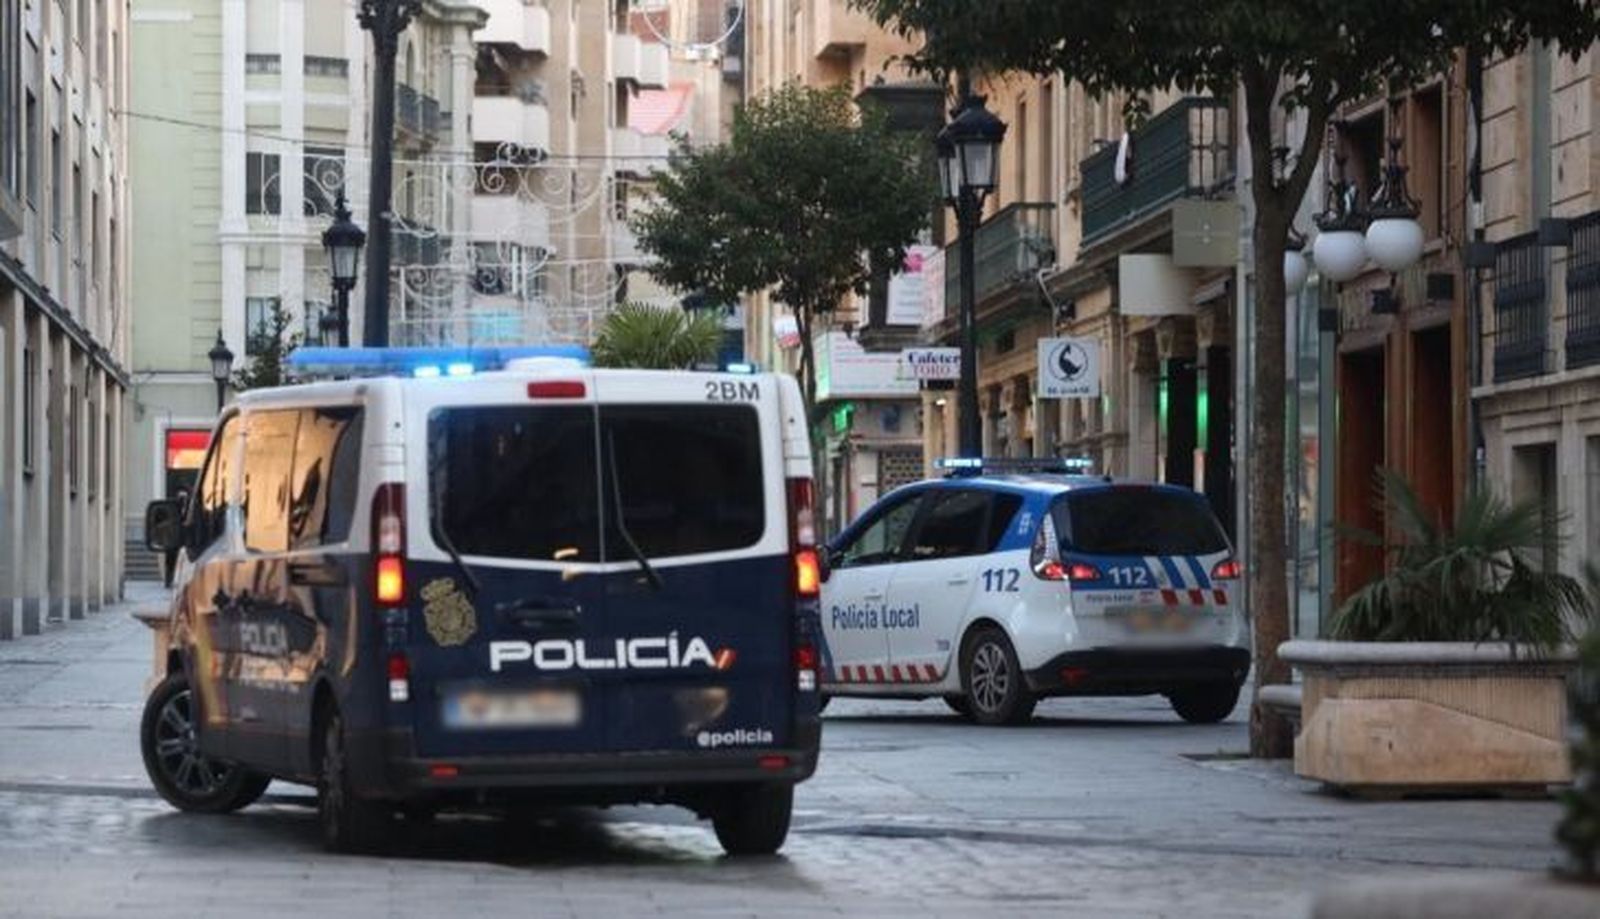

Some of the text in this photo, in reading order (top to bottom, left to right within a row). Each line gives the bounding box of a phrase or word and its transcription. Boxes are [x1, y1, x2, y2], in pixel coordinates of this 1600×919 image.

[908, 351, 961, 364] Cafeter
[705, 381, 760, 401] 2BM
[981, 568, 1020, 592] 112
[1108, 566, 1148, 586] 112
[832, 603, 920, 630] Policía Local
[489, 631, 715, 671] POLICÍA
